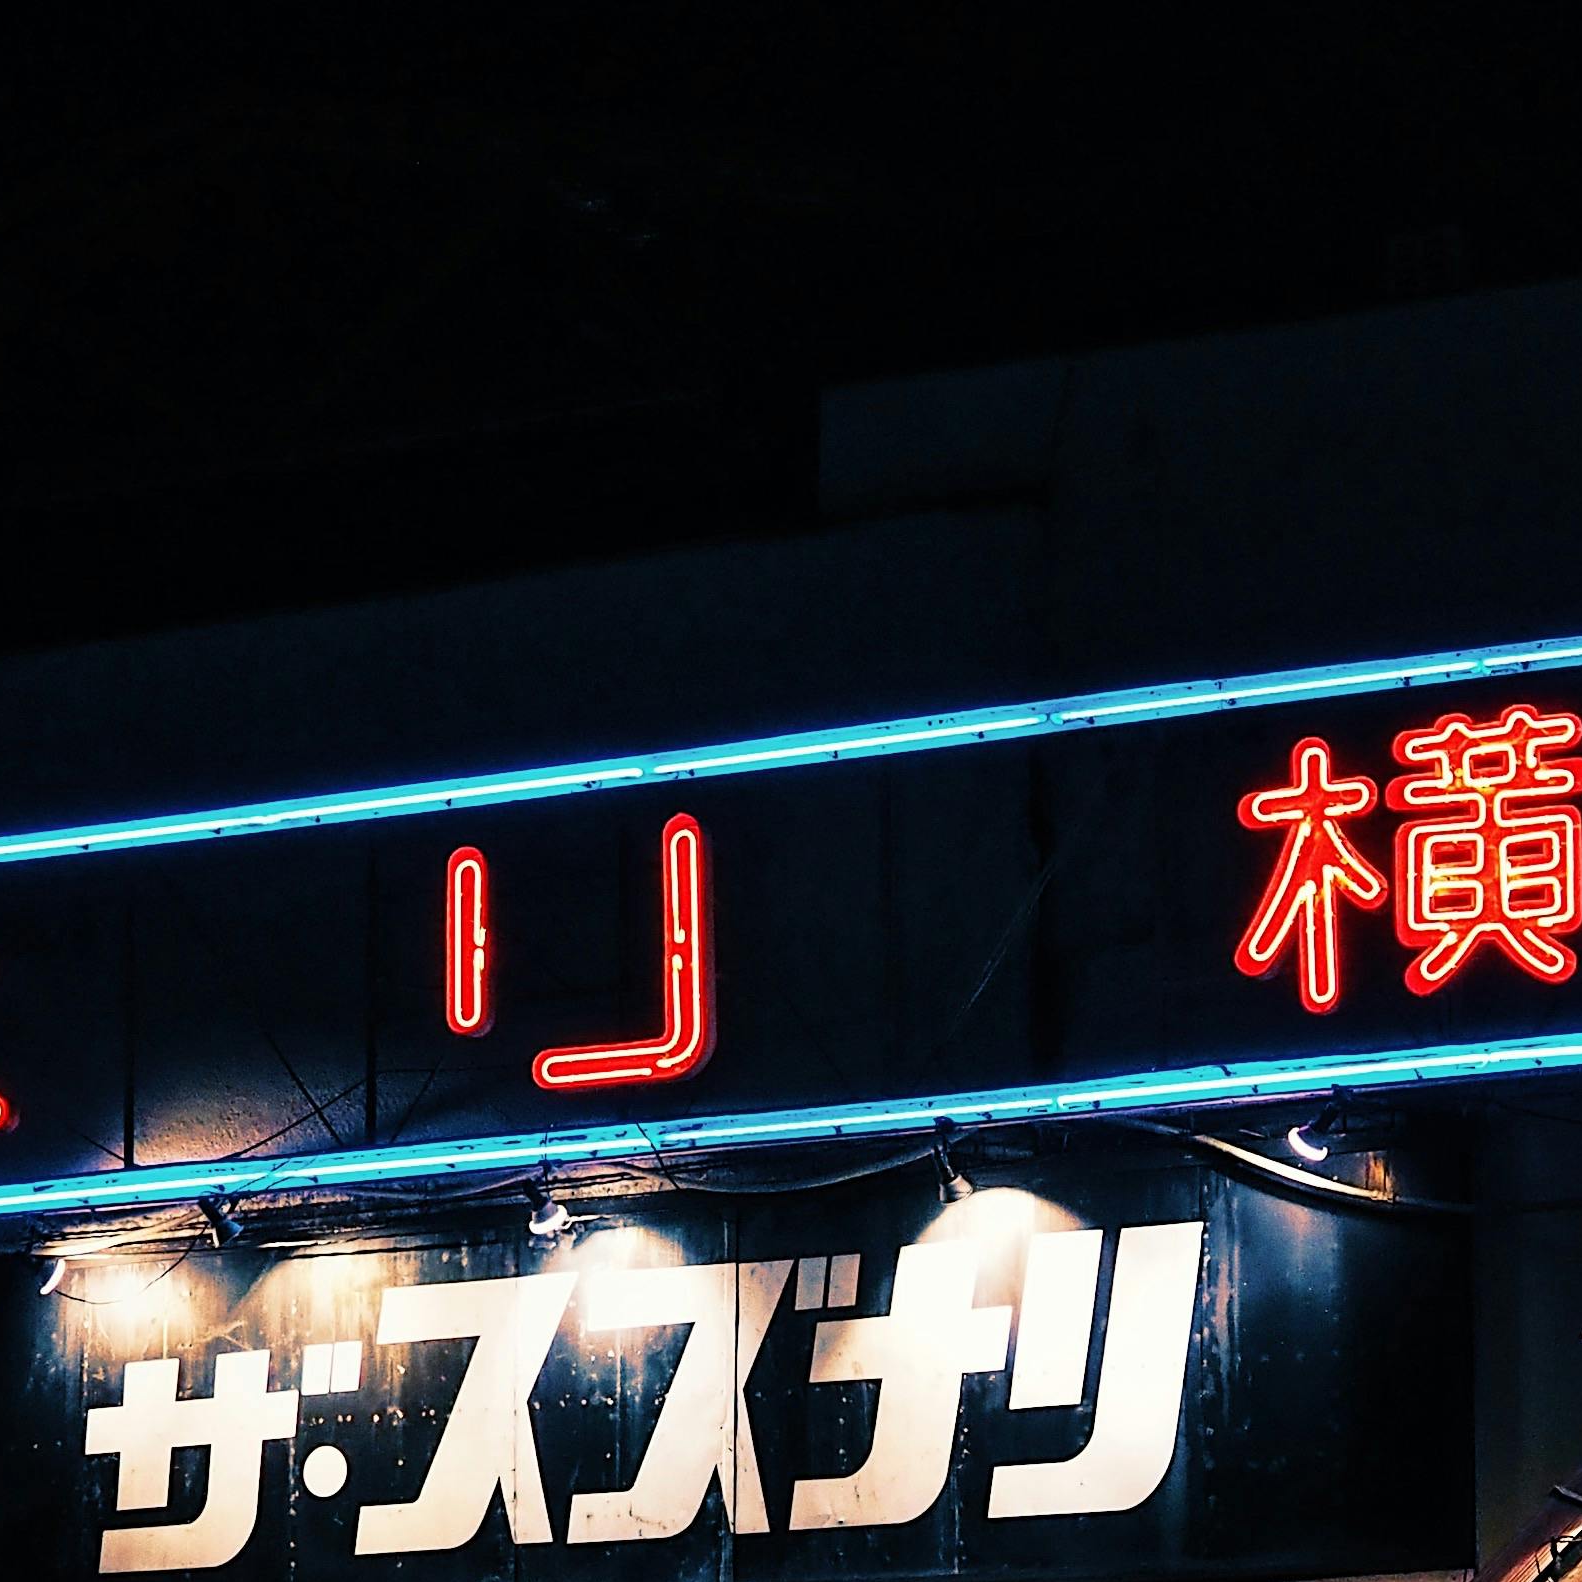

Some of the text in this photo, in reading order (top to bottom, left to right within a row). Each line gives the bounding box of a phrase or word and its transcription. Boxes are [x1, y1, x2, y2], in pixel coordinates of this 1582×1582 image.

[84, 1220, 1205, 1574] ザ・スズナリ
